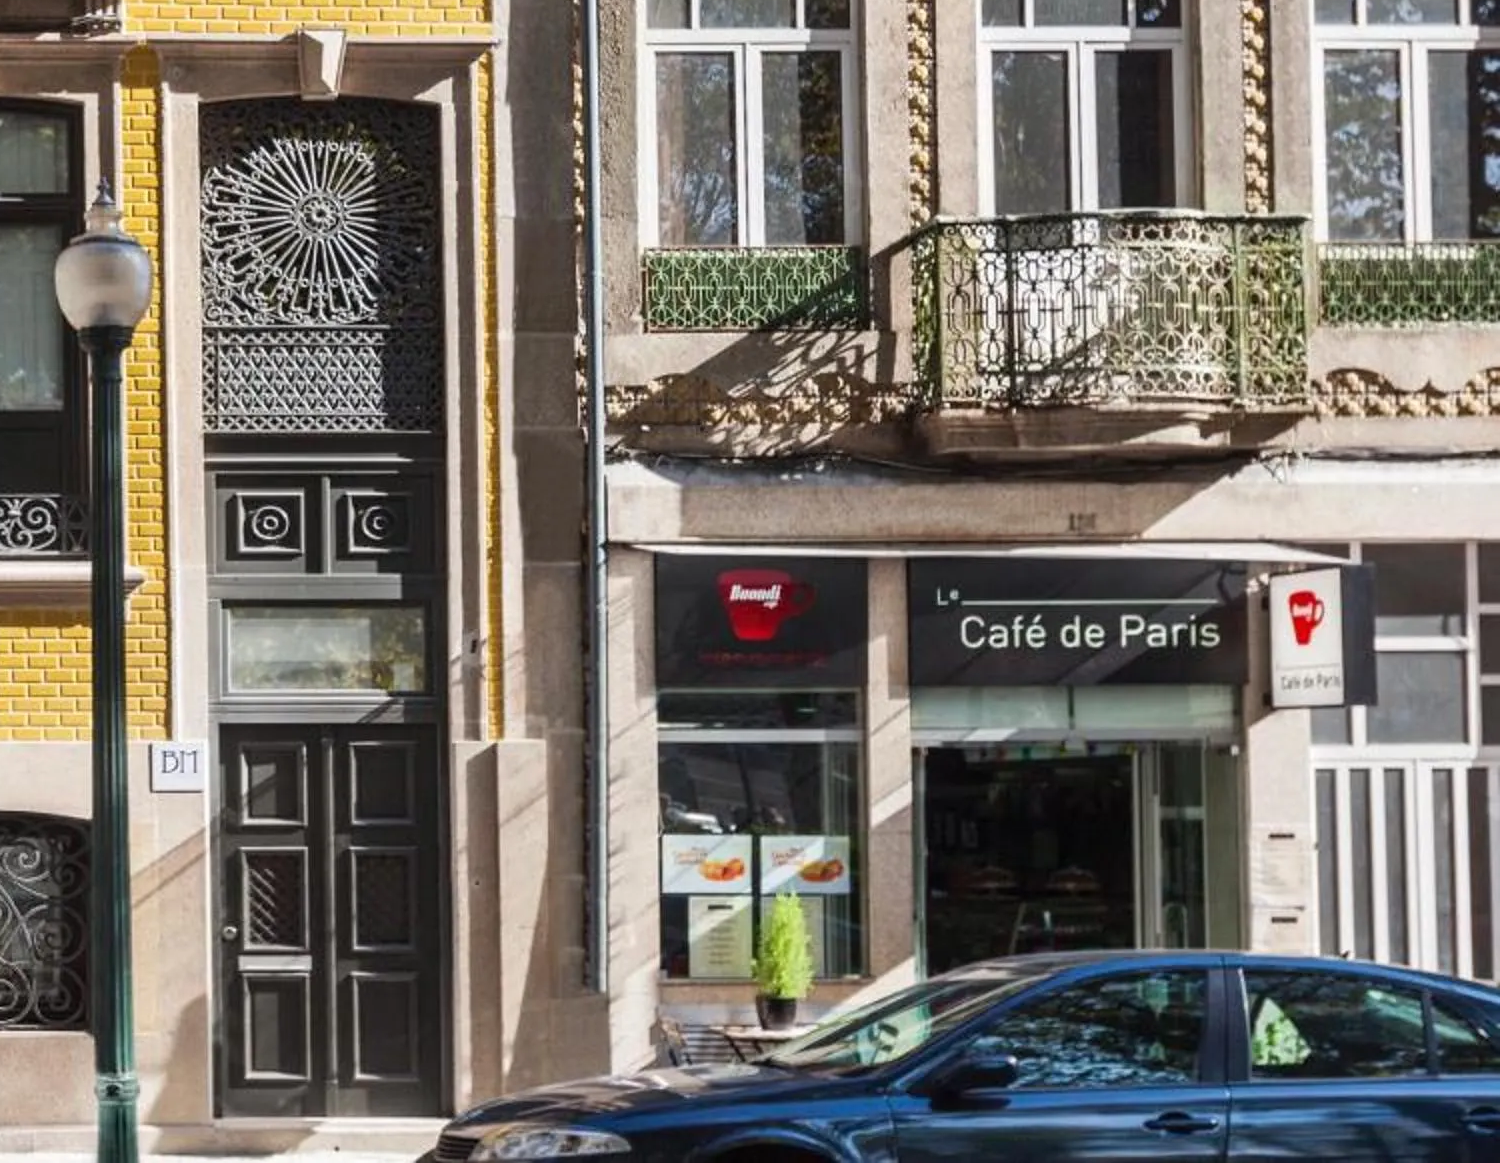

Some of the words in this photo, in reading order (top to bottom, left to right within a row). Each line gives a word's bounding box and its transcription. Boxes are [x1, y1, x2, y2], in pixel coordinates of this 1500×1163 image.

[936, 588, 959, 606] Le
[960, 613, 1047, 649] Café
[1060, 614, 1106, 649] de
[1119, 613, 1221, 649] Paris
